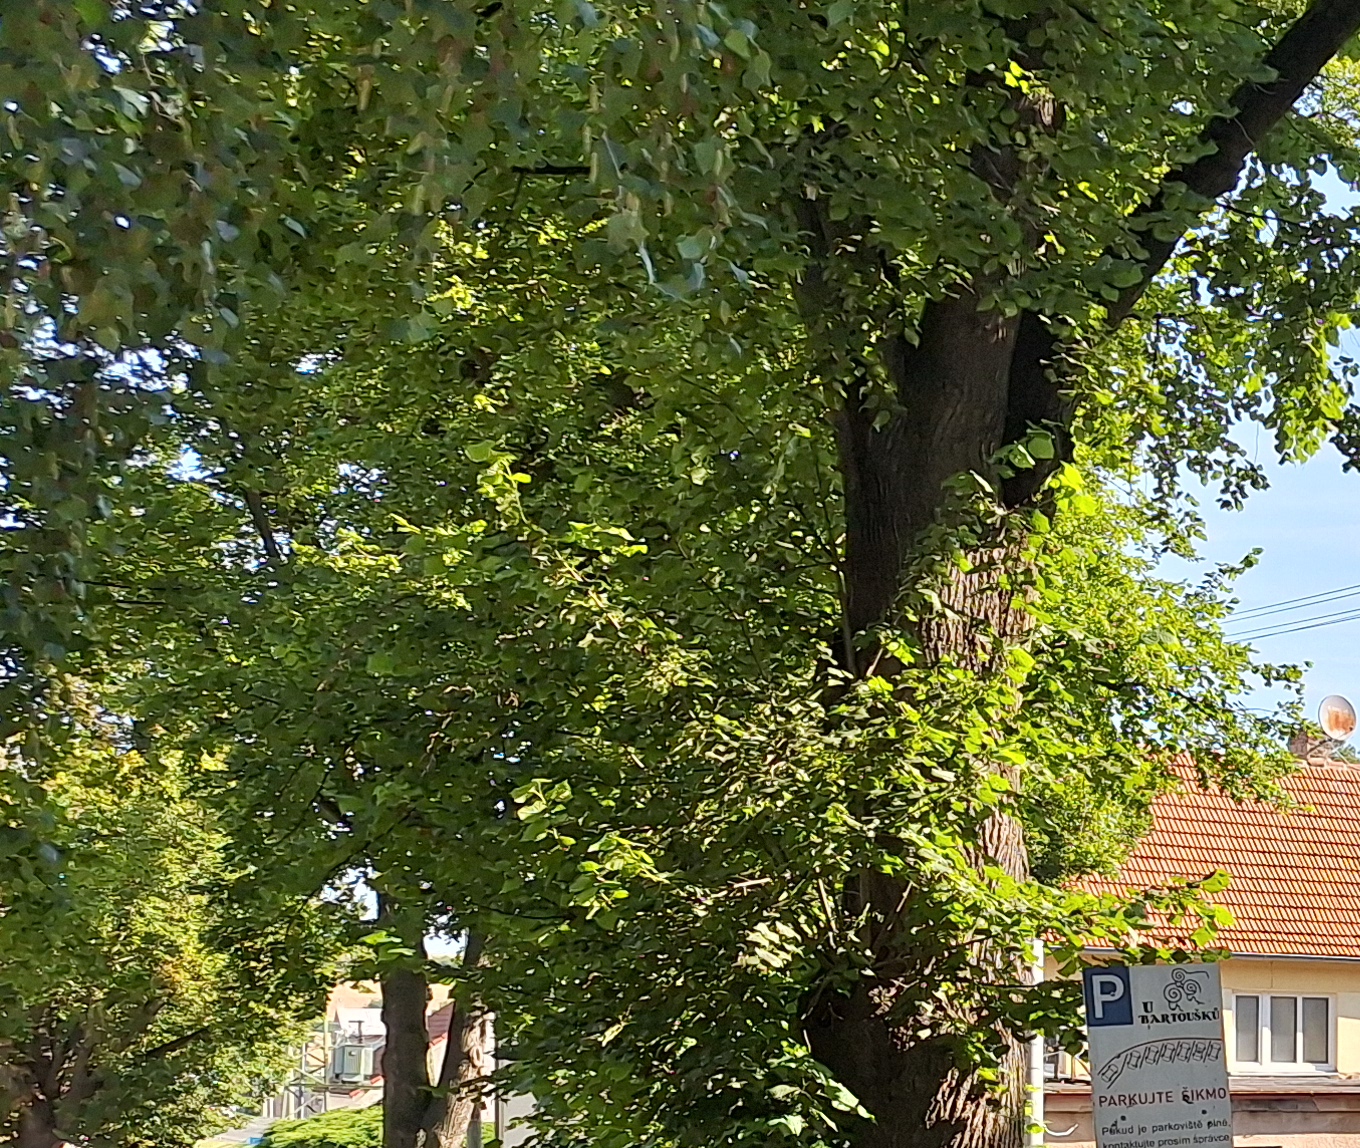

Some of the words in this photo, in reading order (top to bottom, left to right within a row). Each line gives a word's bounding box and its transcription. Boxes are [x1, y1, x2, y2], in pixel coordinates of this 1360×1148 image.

[1091, 974, 1125, 1019] P
[1138, 1007, 1220, 1025] BARTOUŠKŮ
[1142, 1001, 1153, 1013] U
[1098, 1090, 1174, 1108] PARKUJTE
[1181, 1086, 1227, 1104] ŠIKMO
